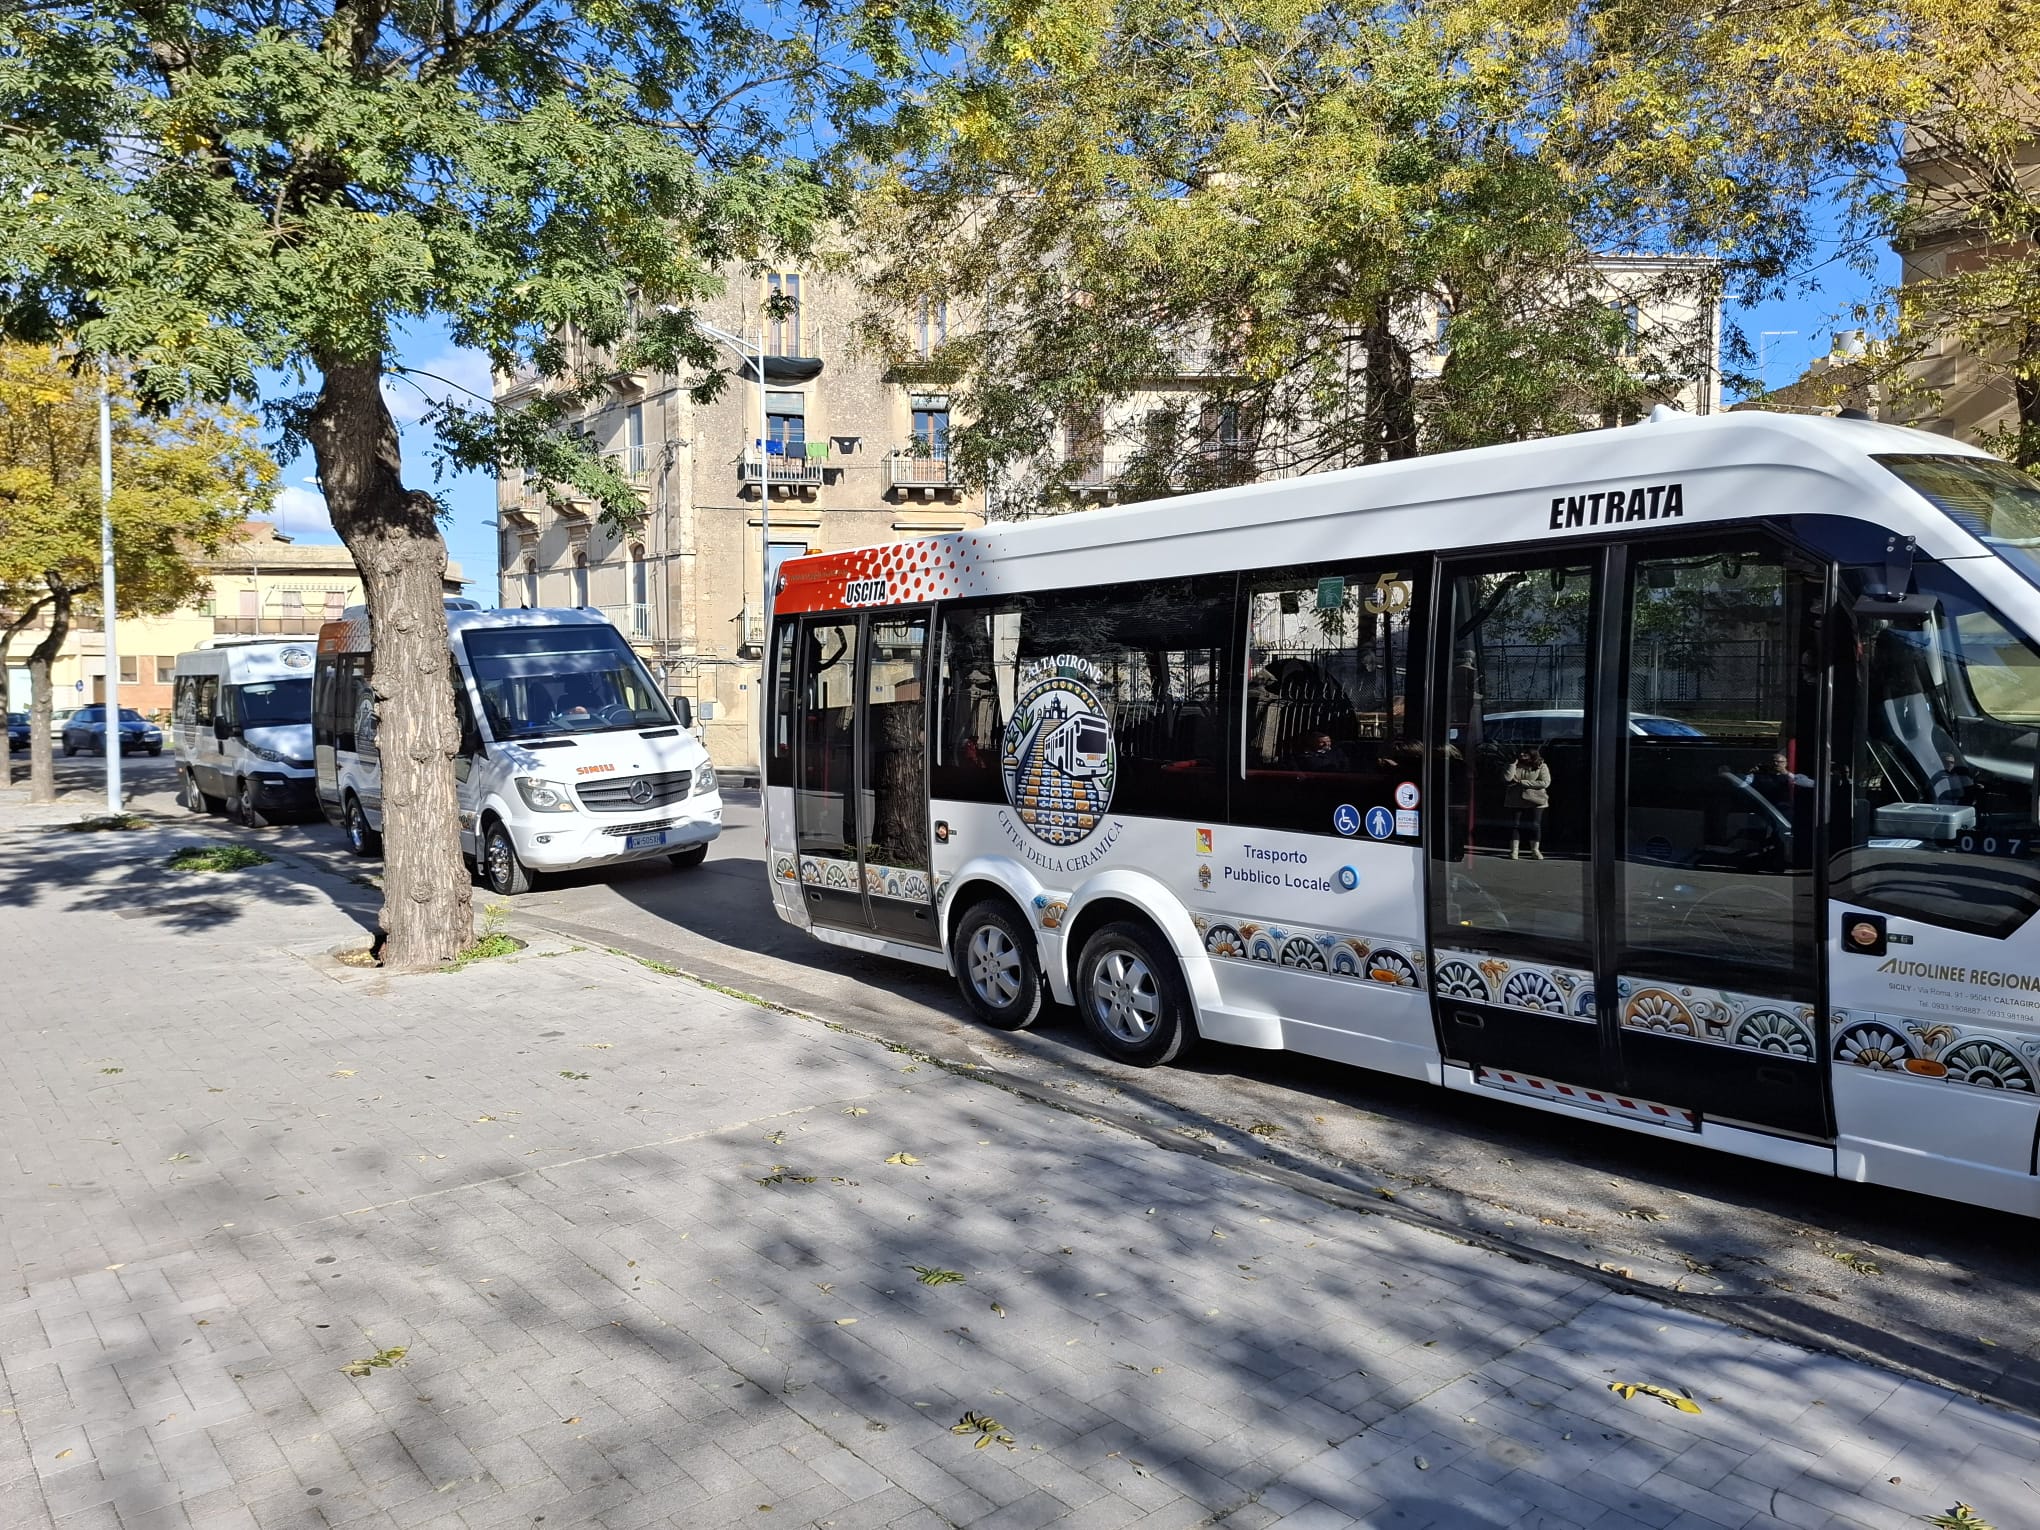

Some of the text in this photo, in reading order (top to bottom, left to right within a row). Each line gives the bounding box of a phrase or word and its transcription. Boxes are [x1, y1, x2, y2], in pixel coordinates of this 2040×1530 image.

[1549, 484, 1684, 530] ENTRATA
[846, 580, 887, 603] USCITA
[1022, 654, 1103, 684] ALTAGIRONE
[1027, 847, 1063, 872] DELLA
[1066, 821, 1124, 872] CERAMICA
[1243, 844, 1308, 864] Trasporto
[1224, 866, 1330, 892] Pubblico Locale
[1876, 957, 2040, 992] AUTOLINEE REGIONA
[1888, 982, 1911, 992] SICILY
[1993, 996, 2040, 1009] CALTAGIRO
